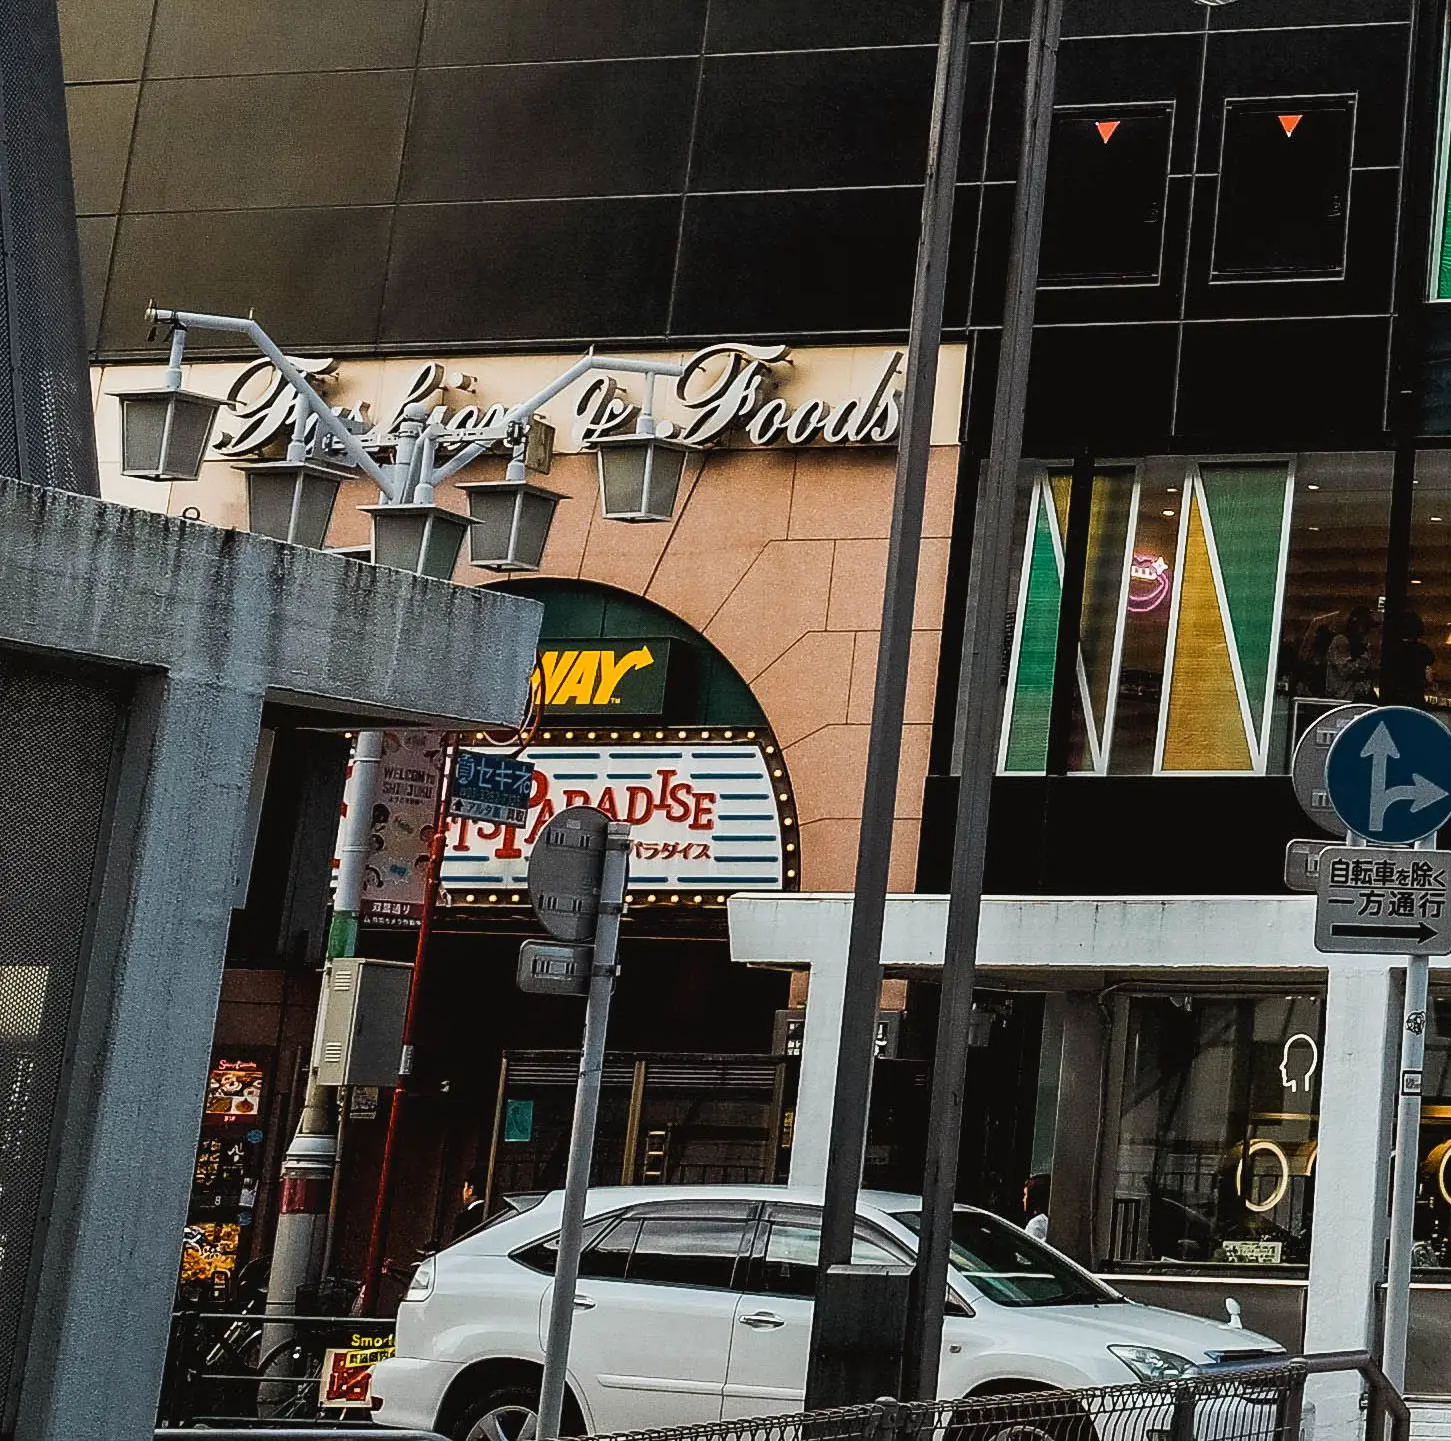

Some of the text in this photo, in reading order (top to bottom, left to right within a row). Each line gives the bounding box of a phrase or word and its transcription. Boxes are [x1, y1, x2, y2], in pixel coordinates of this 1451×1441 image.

[656, 342, 904, 448] Foods
[1329, 858, 1447, 888] 自転車を除く
[1327, 889, 1447, 919] 一方通行
